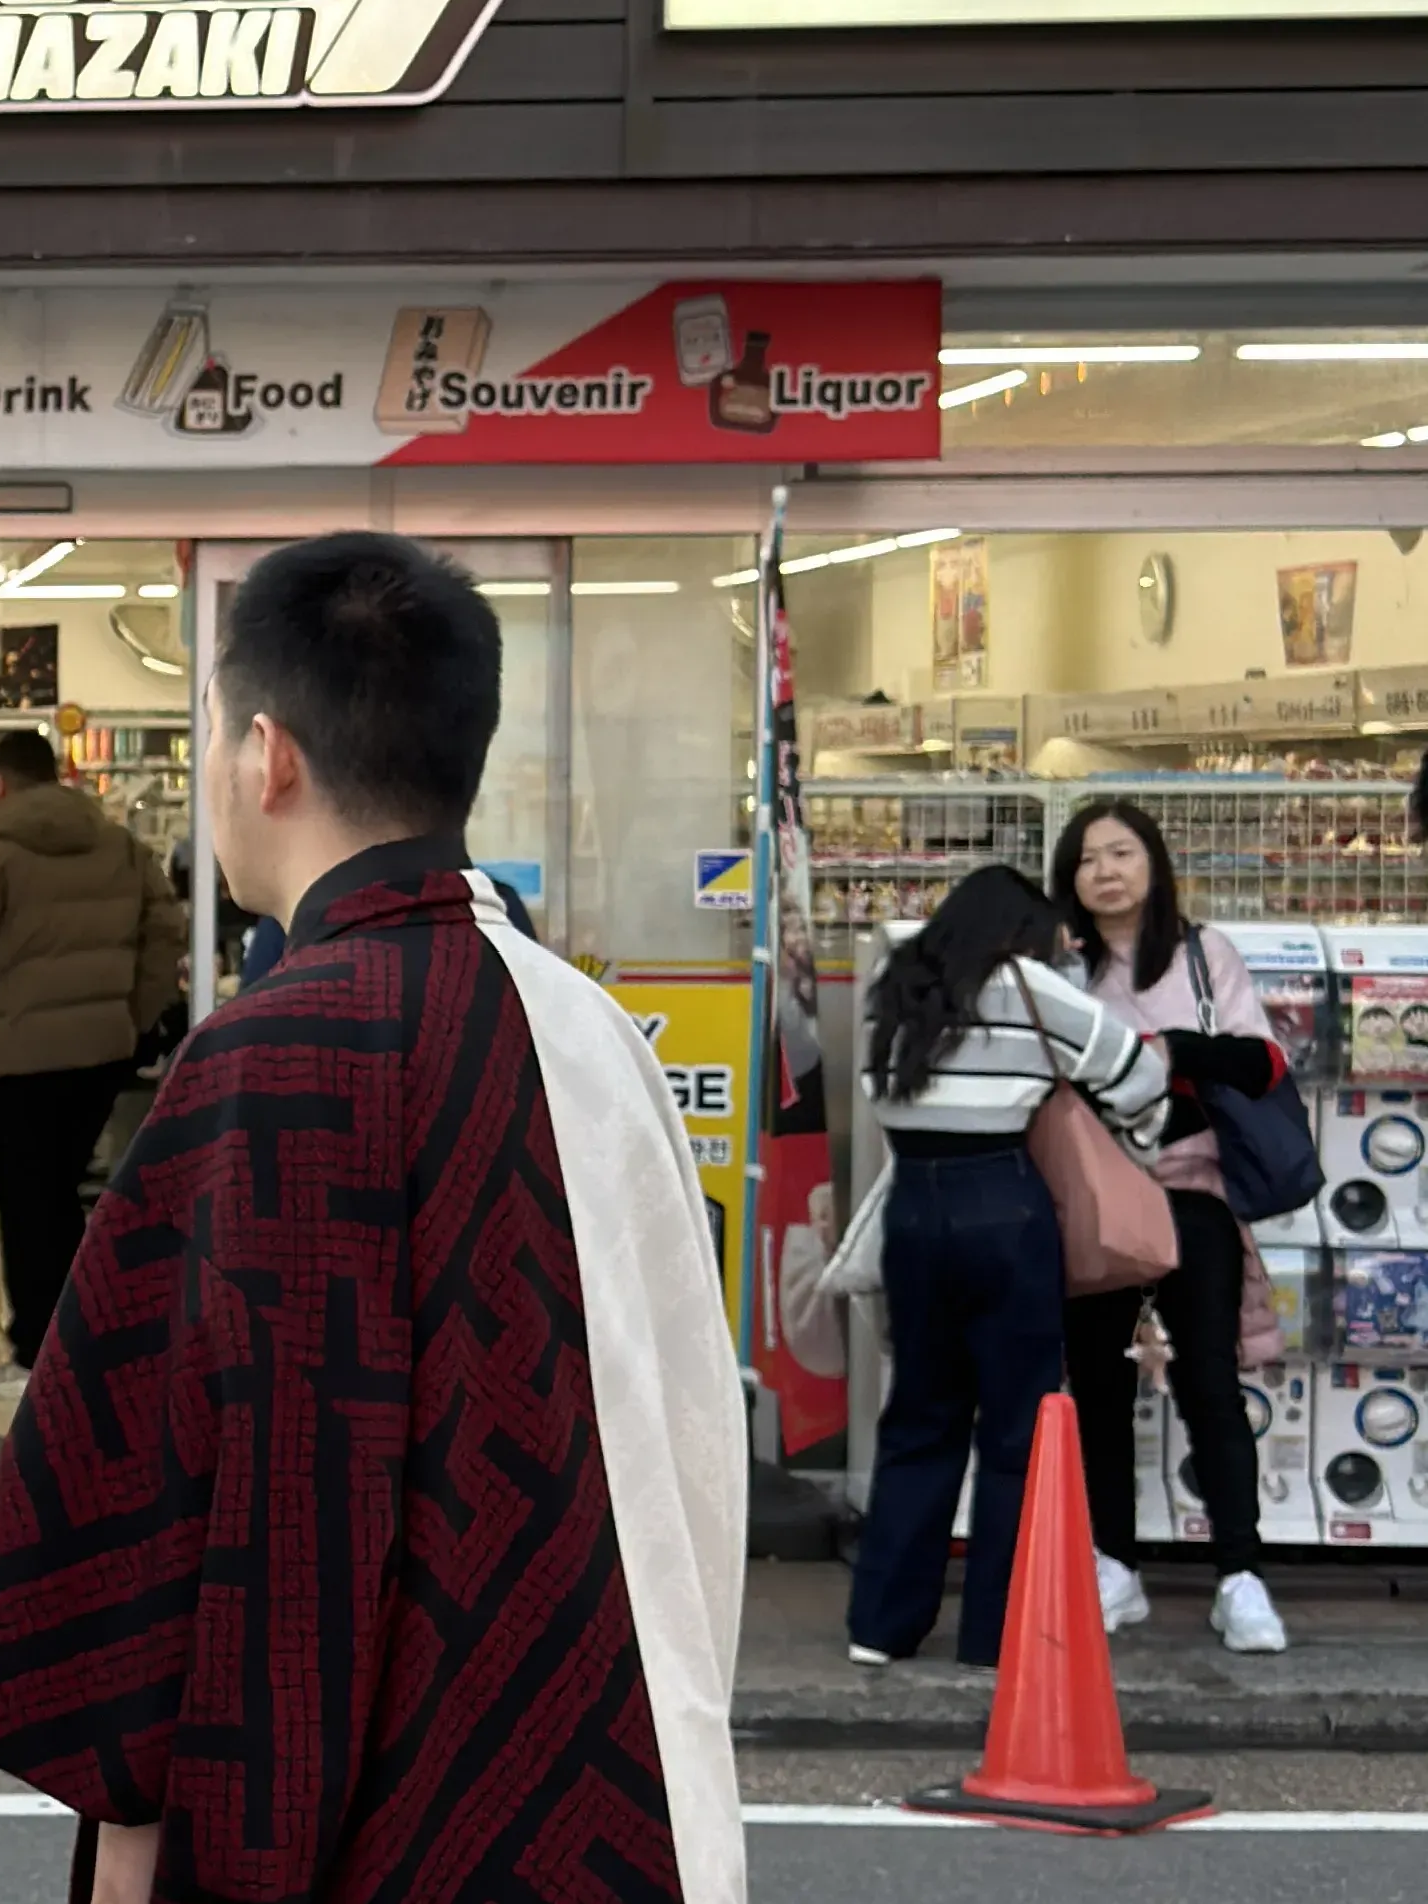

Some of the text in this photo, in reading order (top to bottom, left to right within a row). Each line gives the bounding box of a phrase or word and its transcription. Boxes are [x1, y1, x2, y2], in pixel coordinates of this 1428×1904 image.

[233, 372, 344, 410] Food
[439, 371, 648, 410] Souvenir
[774, 368, 927, 415] Liquor
